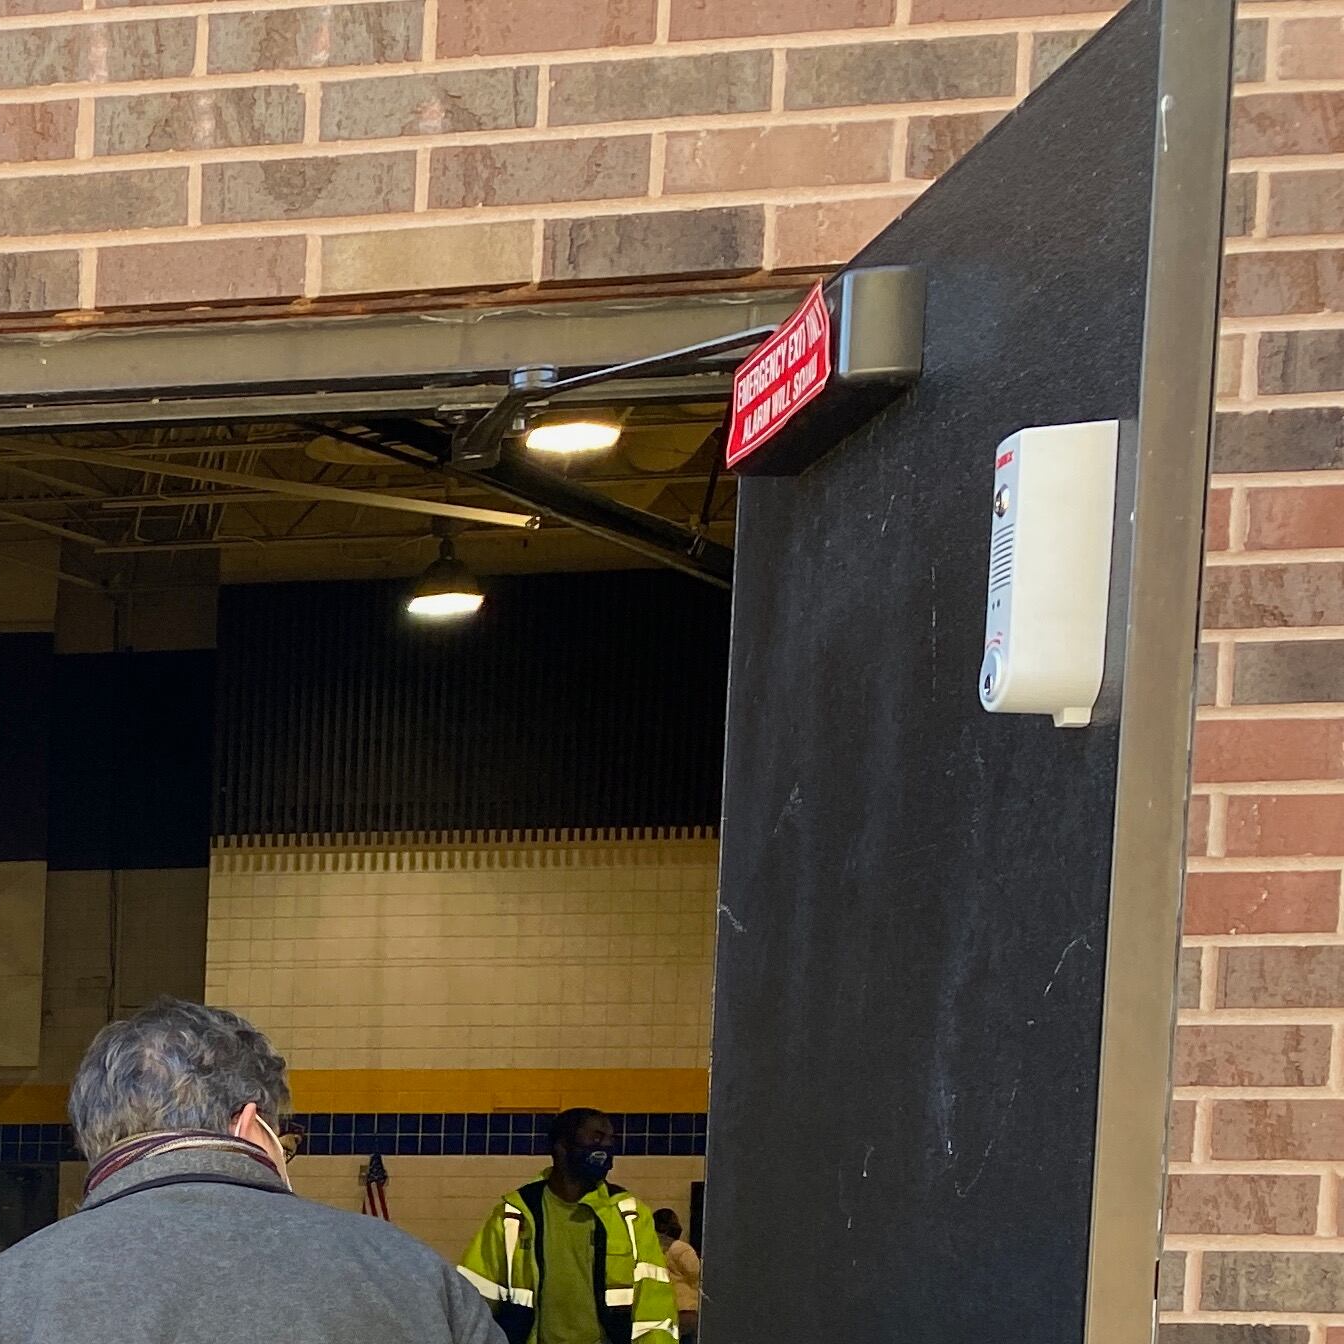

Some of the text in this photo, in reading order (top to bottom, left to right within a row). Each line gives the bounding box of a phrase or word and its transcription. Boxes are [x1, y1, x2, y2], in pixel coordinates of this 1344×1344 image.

[737, 342, 787, 413] EMERGENCY
[787, 321, 807, 371] EXIT
[742, 352, 818, 445] ALARM WILL SOUND
